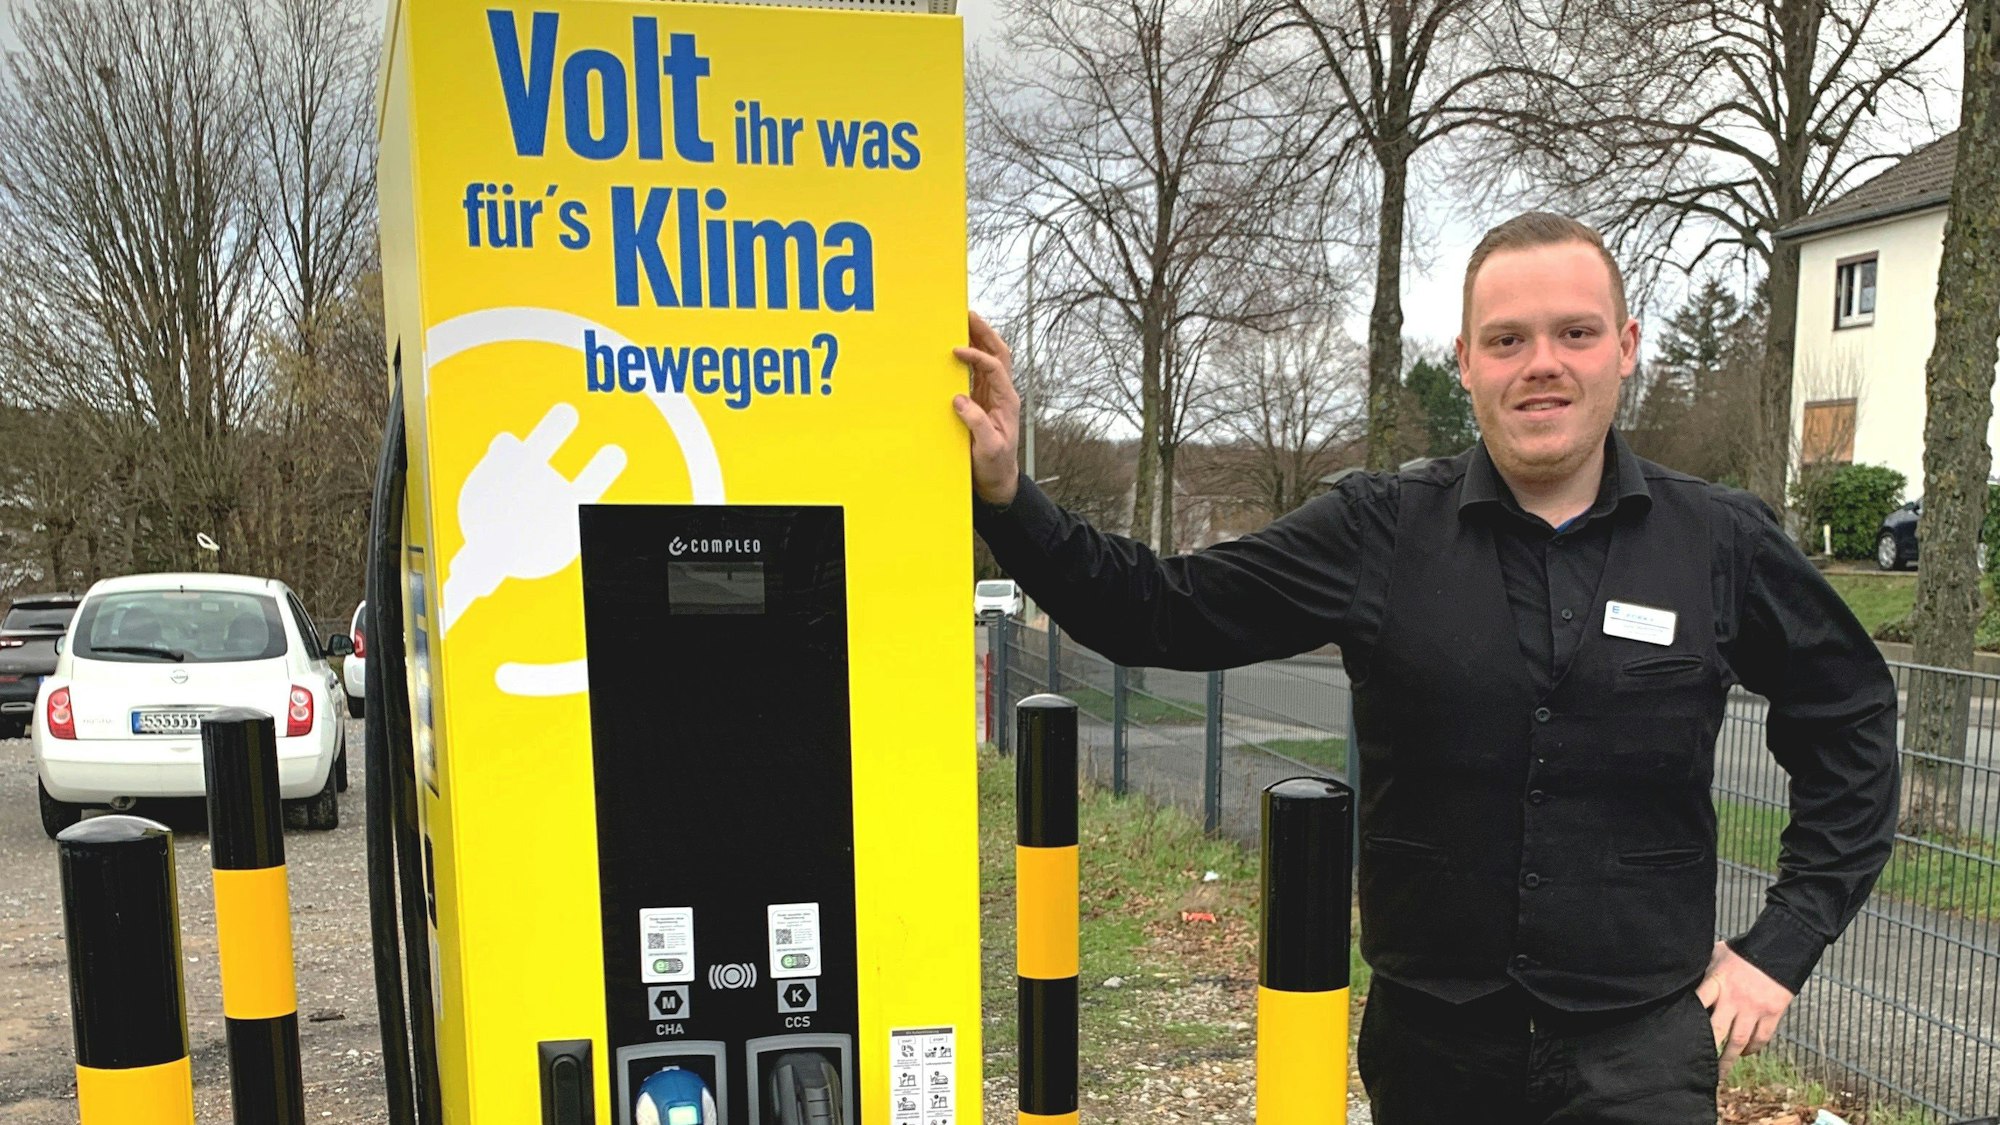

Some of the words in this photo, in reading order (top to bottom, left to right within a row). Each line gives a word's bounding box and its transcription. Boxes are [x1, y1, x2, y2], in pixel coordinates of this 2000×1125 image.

[486, 9, 714, 163] Volt
[734, 100, 804, 166] ihr
[817, 119, 921, 171] was
[610, 185, 875, 312] Klima
[584, 329, 839, 409] bewegen?
[690, 538, 761, 553] COMPLEO
[792, 989, 804, 1002] K
[661, 996, 676, 1010] M
[784, 1015, 811, 1029] CCS
[655, 1023, 685, 1036] CHA
